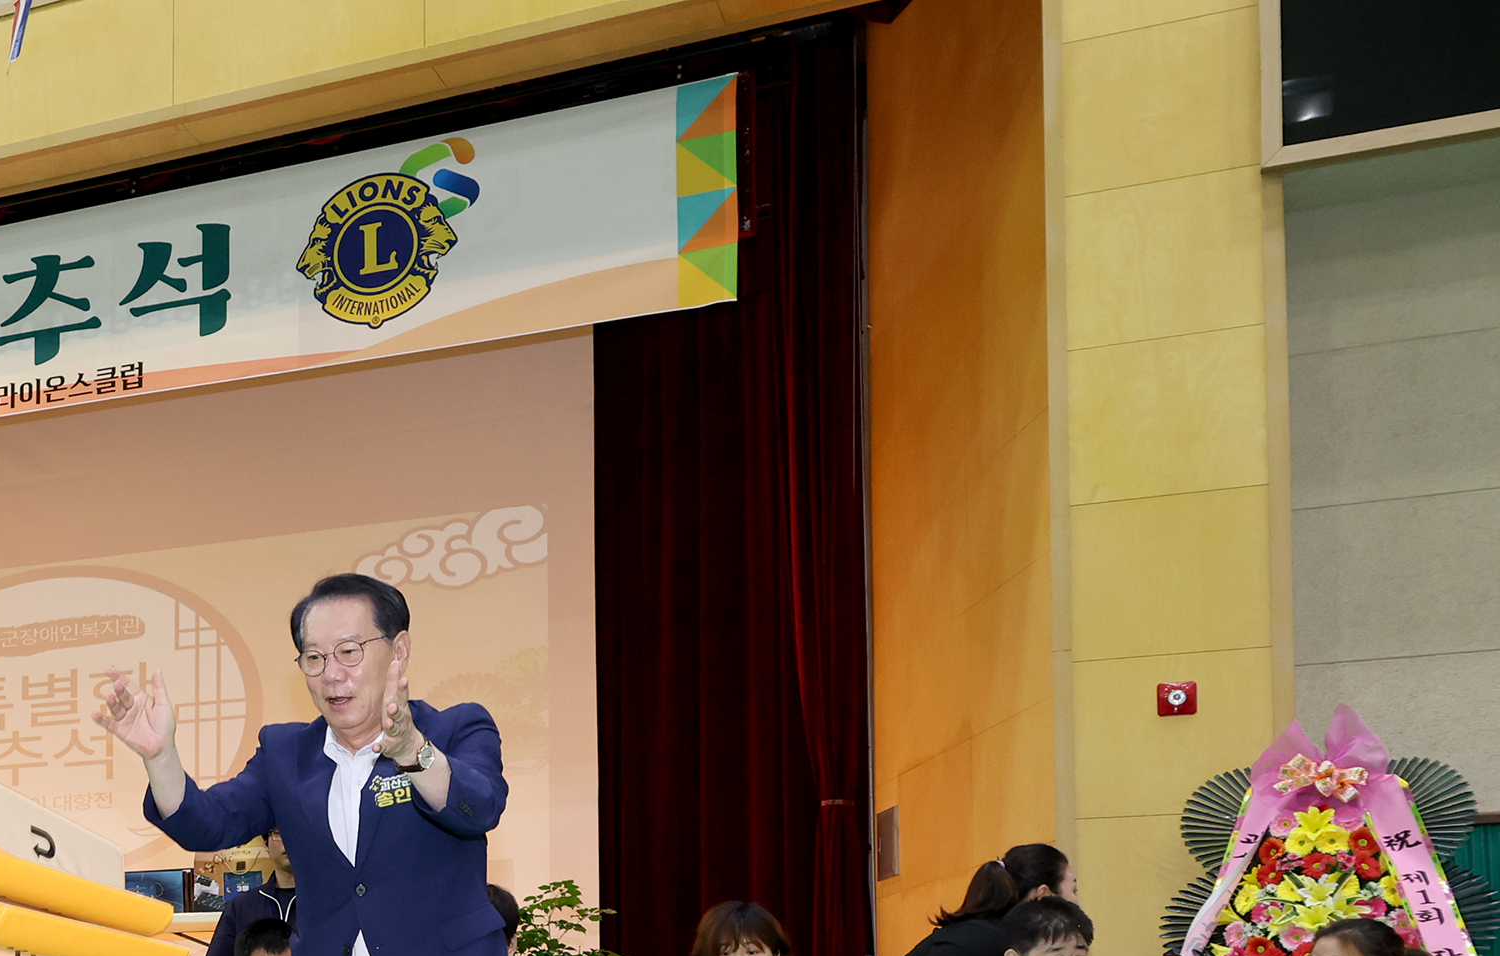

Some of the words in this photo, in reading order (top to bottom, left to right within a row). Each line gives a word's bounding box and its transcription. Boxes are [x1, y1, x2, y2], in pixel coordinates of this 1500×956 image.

[330, 178, 422, 219] LIONS
[358, 221, 399, 276] L
[331, 281, 422, 317] INTERNATIONAL
[52, 791, 113, 812] 대항전
[1382, 829, 1422, 852] 祝
